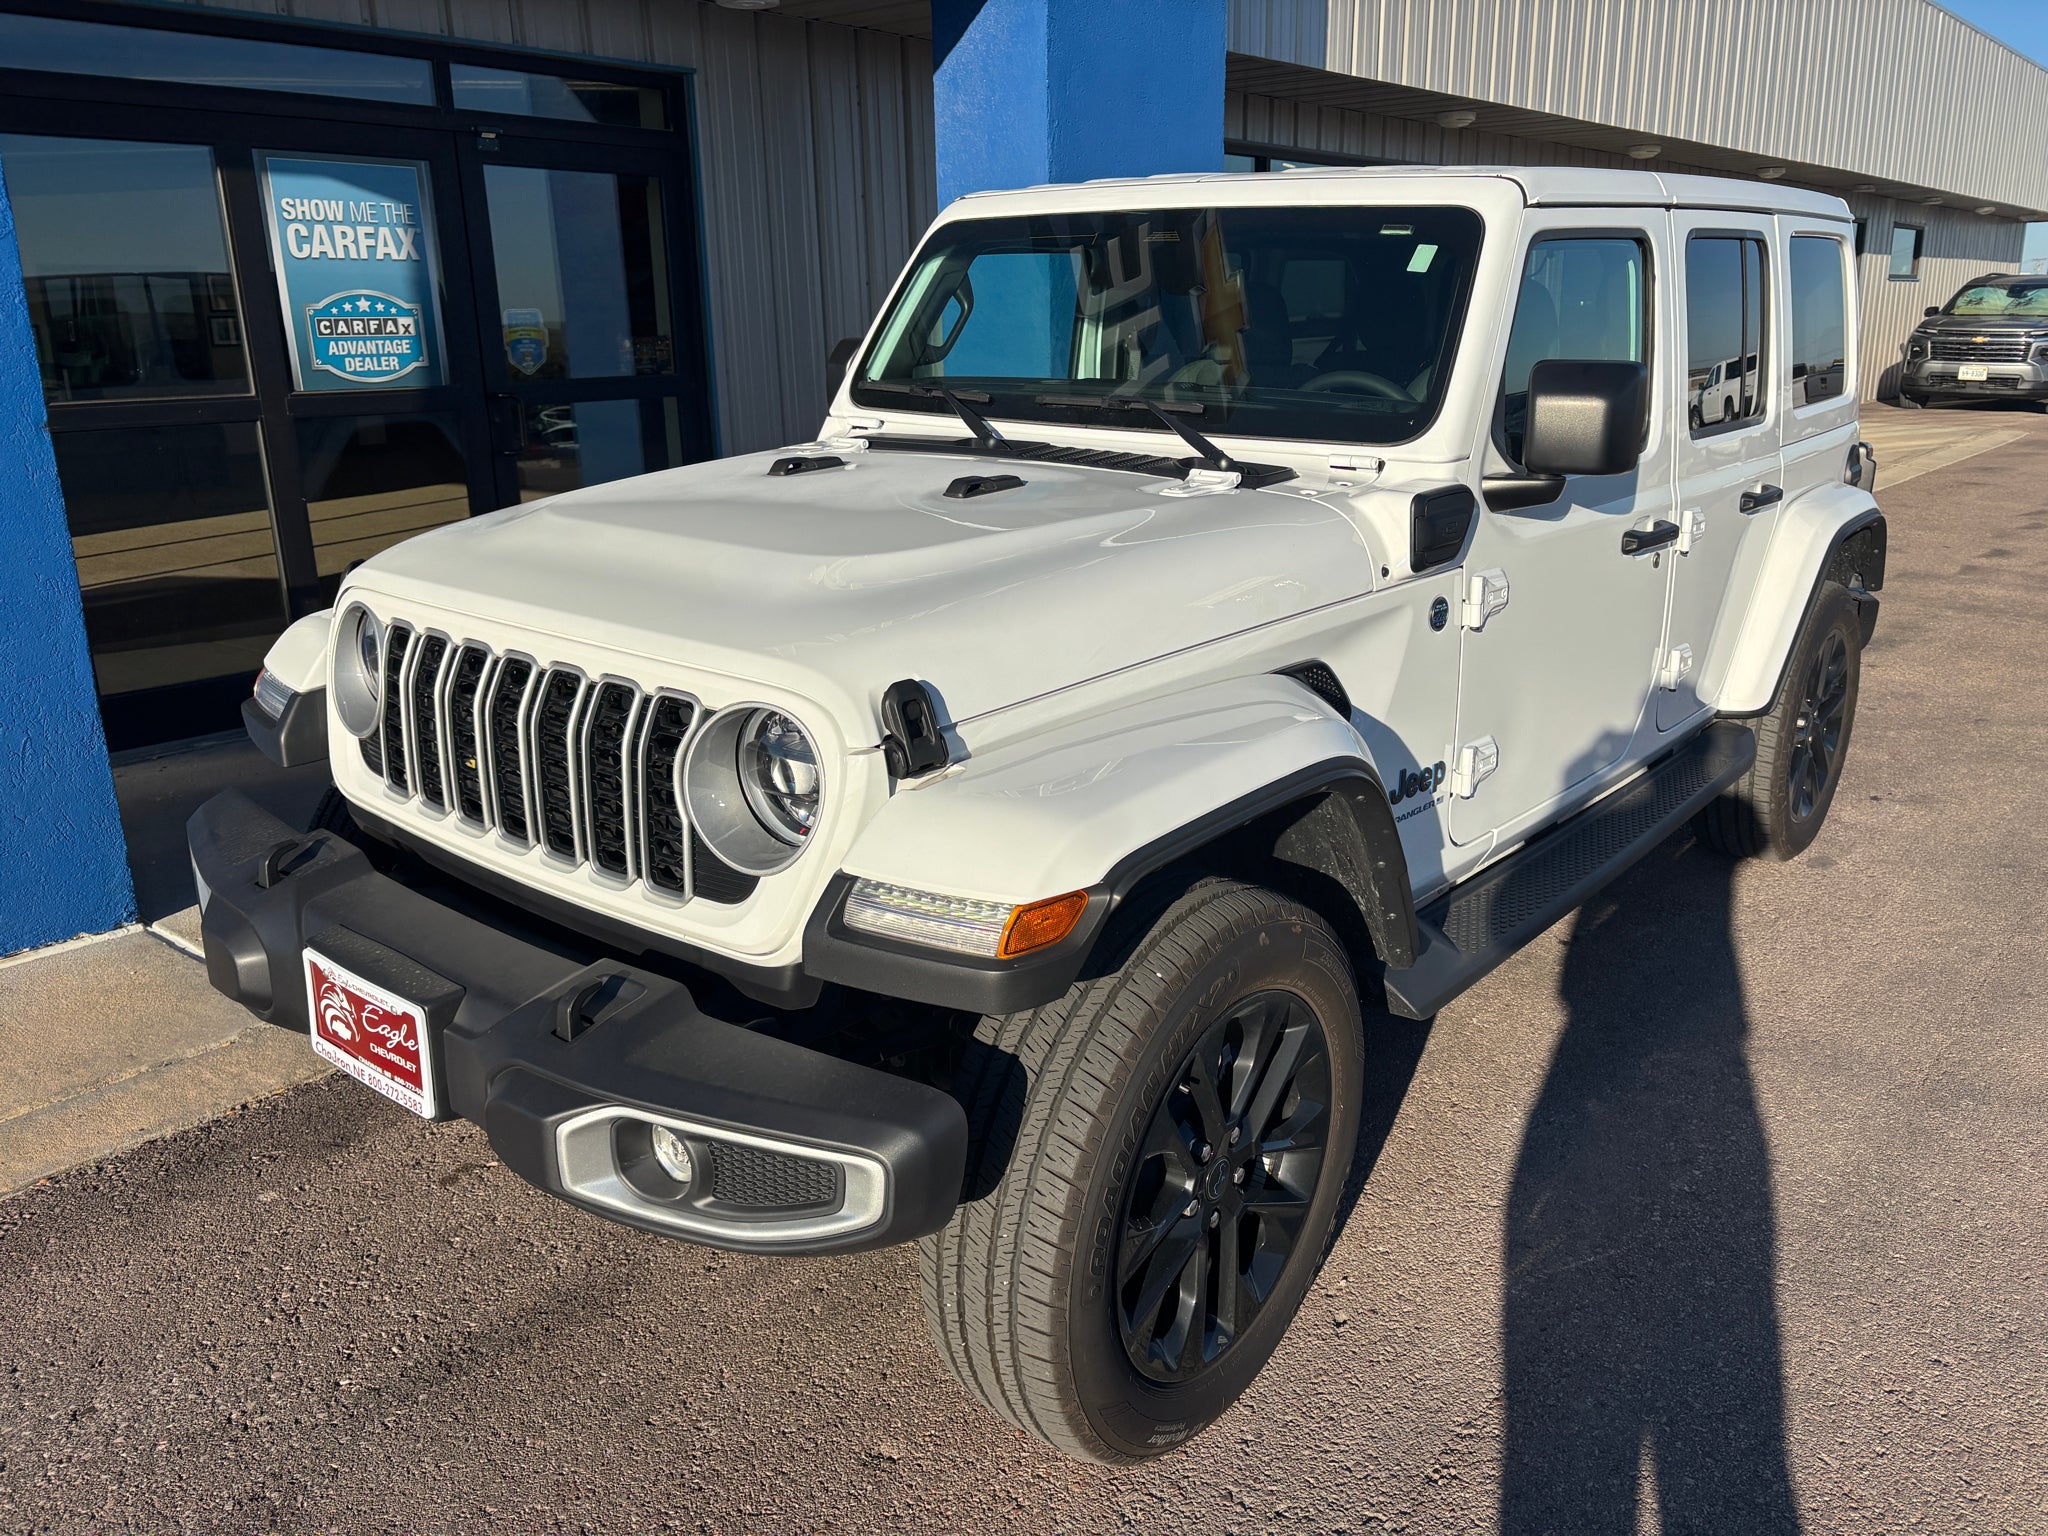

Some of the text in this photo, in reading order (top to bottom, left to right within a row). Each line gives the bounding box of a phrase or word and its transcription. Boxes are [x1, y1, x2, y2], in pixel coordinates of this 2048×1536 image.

[280, 197, 416, 225] SHOW ME THE
[286, 223, 420, 260] CARFAX
[318, 318, 413, 336] CARFAX
[328, 339, 411, 356] ADVANTAGE
[345, 356, 400, 372] DEALER
[1389, 760, 1446, 805] Jeep
[361, 1004, 418, 1050] Eagle
[369, 1042, 417, 1074] CHEVROLET
[367, 1073, 423, 1114] 800-272-5583
